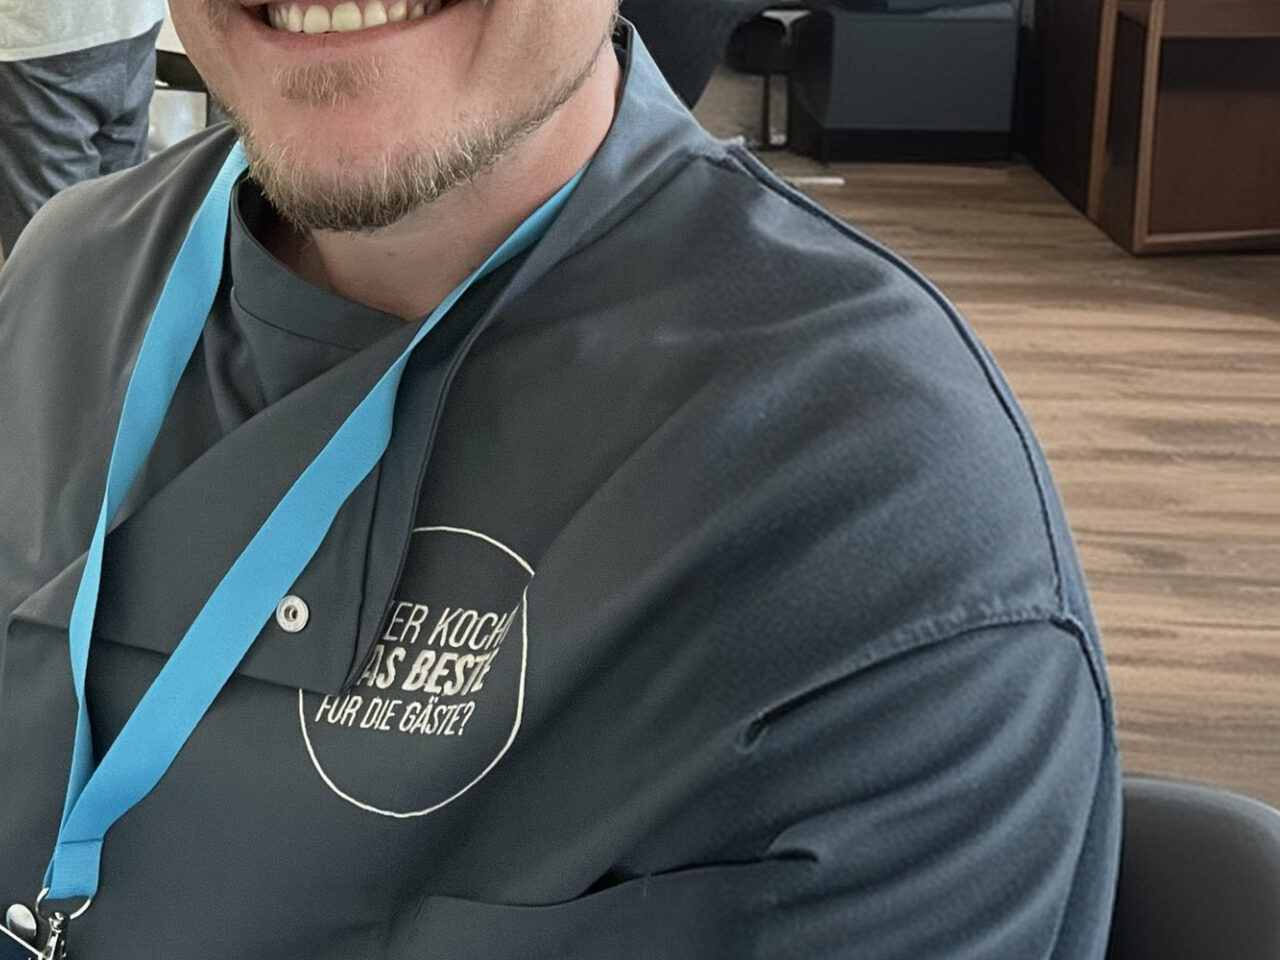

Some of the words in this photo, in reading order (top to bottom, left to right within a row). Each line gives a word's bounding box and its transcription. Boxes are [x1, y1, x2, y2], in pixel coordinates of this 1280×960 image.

[383, 600, 429, 644] ER
[356, 644, 406, 691] AS
[360, 696, 403, 731] DIE
[399, 697, 476, 737] GÄSTE?
